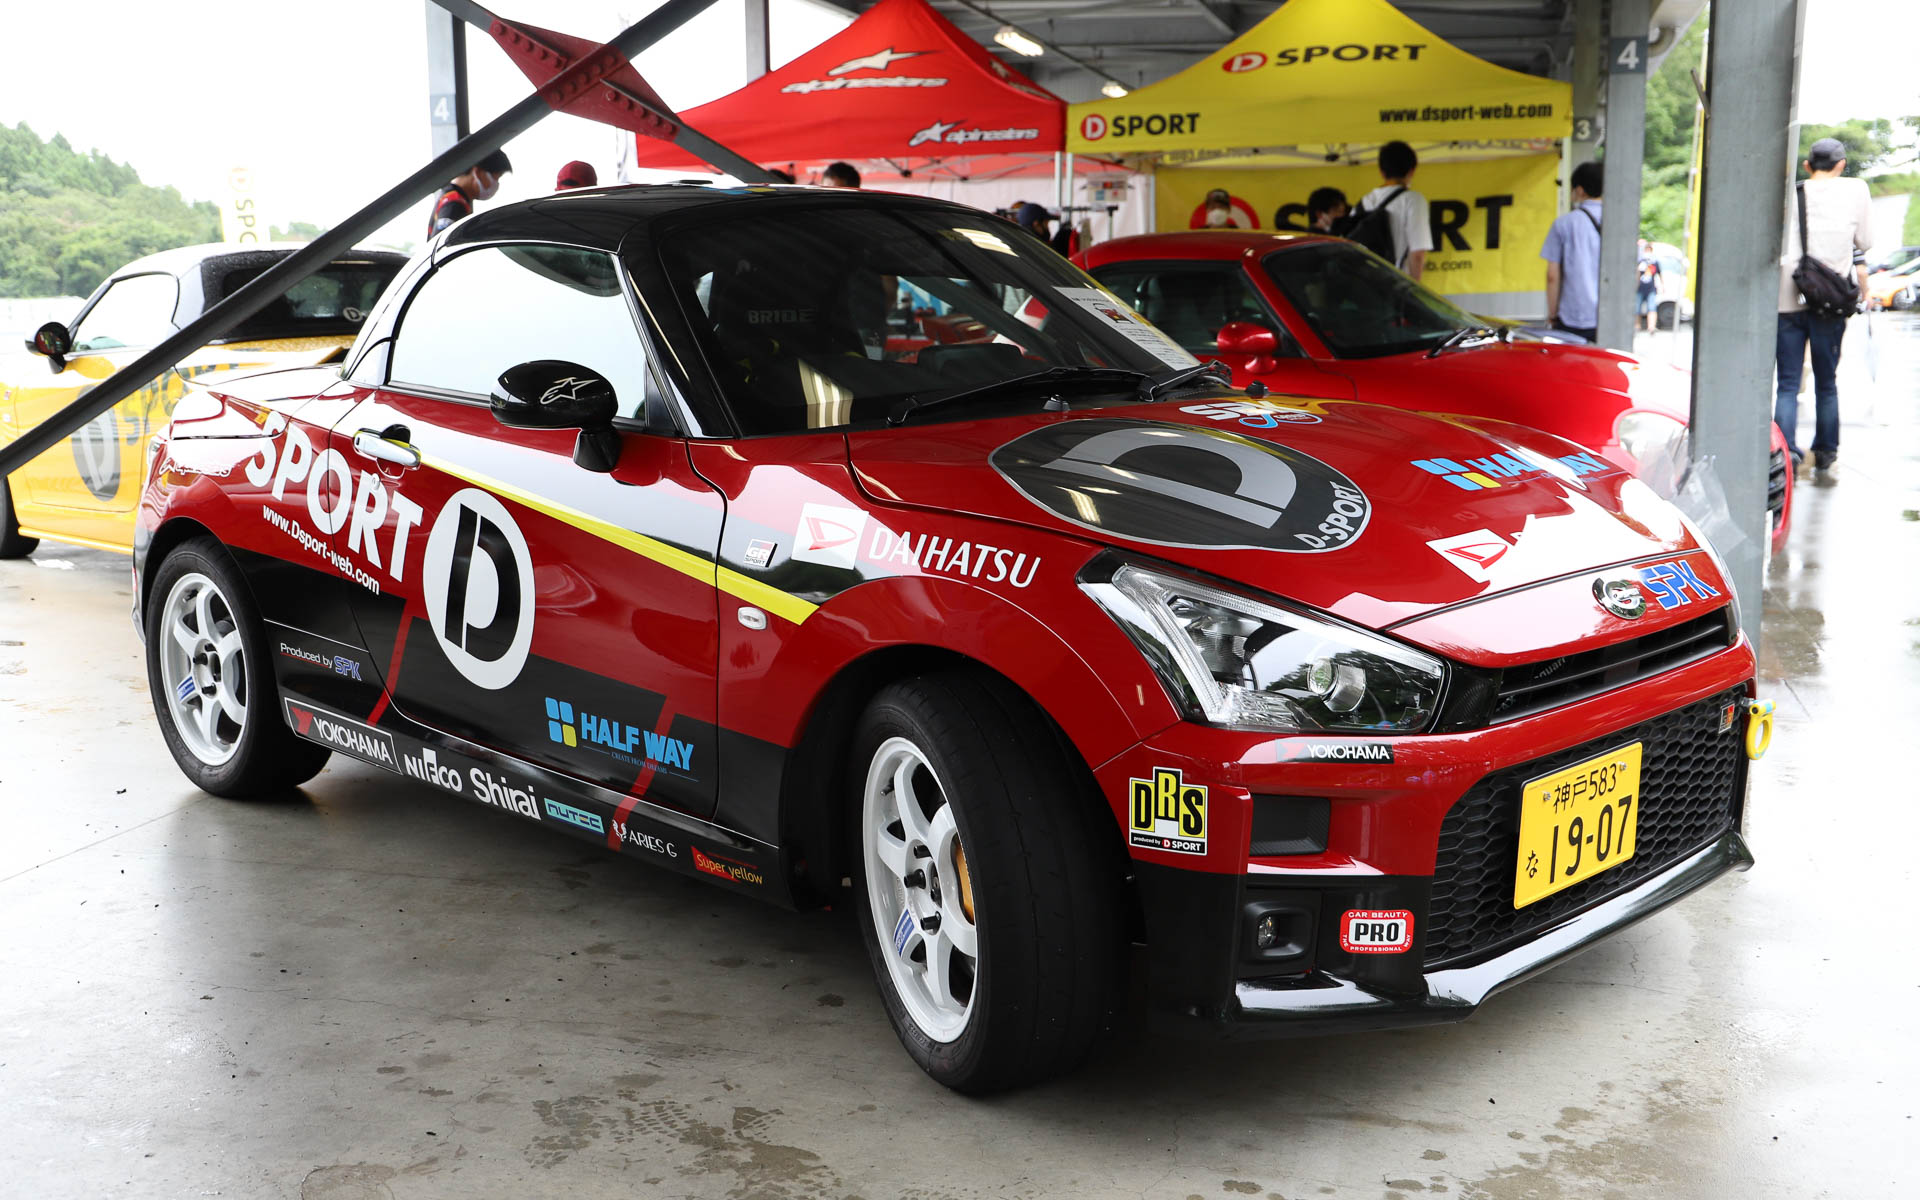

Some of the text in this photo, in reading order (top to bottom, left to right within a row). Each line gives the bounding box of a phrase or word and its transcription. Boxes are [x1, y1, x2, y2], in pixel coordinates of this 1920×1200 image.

[1275, 44, 1427, 66] SPORT
[1617, 40, 1640, 69] 4
[434, 96, 450, 121] 4
[1379, 103, 1553, 122] www.dsport-web.com
[945, 127, 1040, 144] alpinestars
[1111, 112, 1200, 137] SPORT
[1576, 119, 1591, 140] 3
[1274, 194, 1515, 253] SRT
[244, 410, 424, 583] SPORT
[1293, 480, 1364, 549] D-SPORT
[262, 504, 381, 596] www.Dsport-web.com
[868, 526, 1042, 589] DAIHATSU
[1638, 559, 1722, 611] SPK
[280, 642, 362, 681] Produced by SPK
[312, 715, 393, 765] YOKOHAMA
[580, 712, 695, 771] HALF WAY
[1306, 743, 1391, 760] YOKOHAMA
[469, 767, 542, 821] Shirai
[1134, 772, 1204, 836] DRS
[629, 830, 678, 858] ARIES G
[1133, 836, 1154, 844] produced
[1171, 841, 1201, 851] SPORT
[1550, 795, 1633, 884] 19-07
[696, 854, 726, 873] Super
[727, 865, 763, 885] yellow
[1526, 850, 1539, 879] な
[1354, 922, 1399, 942] PRO
